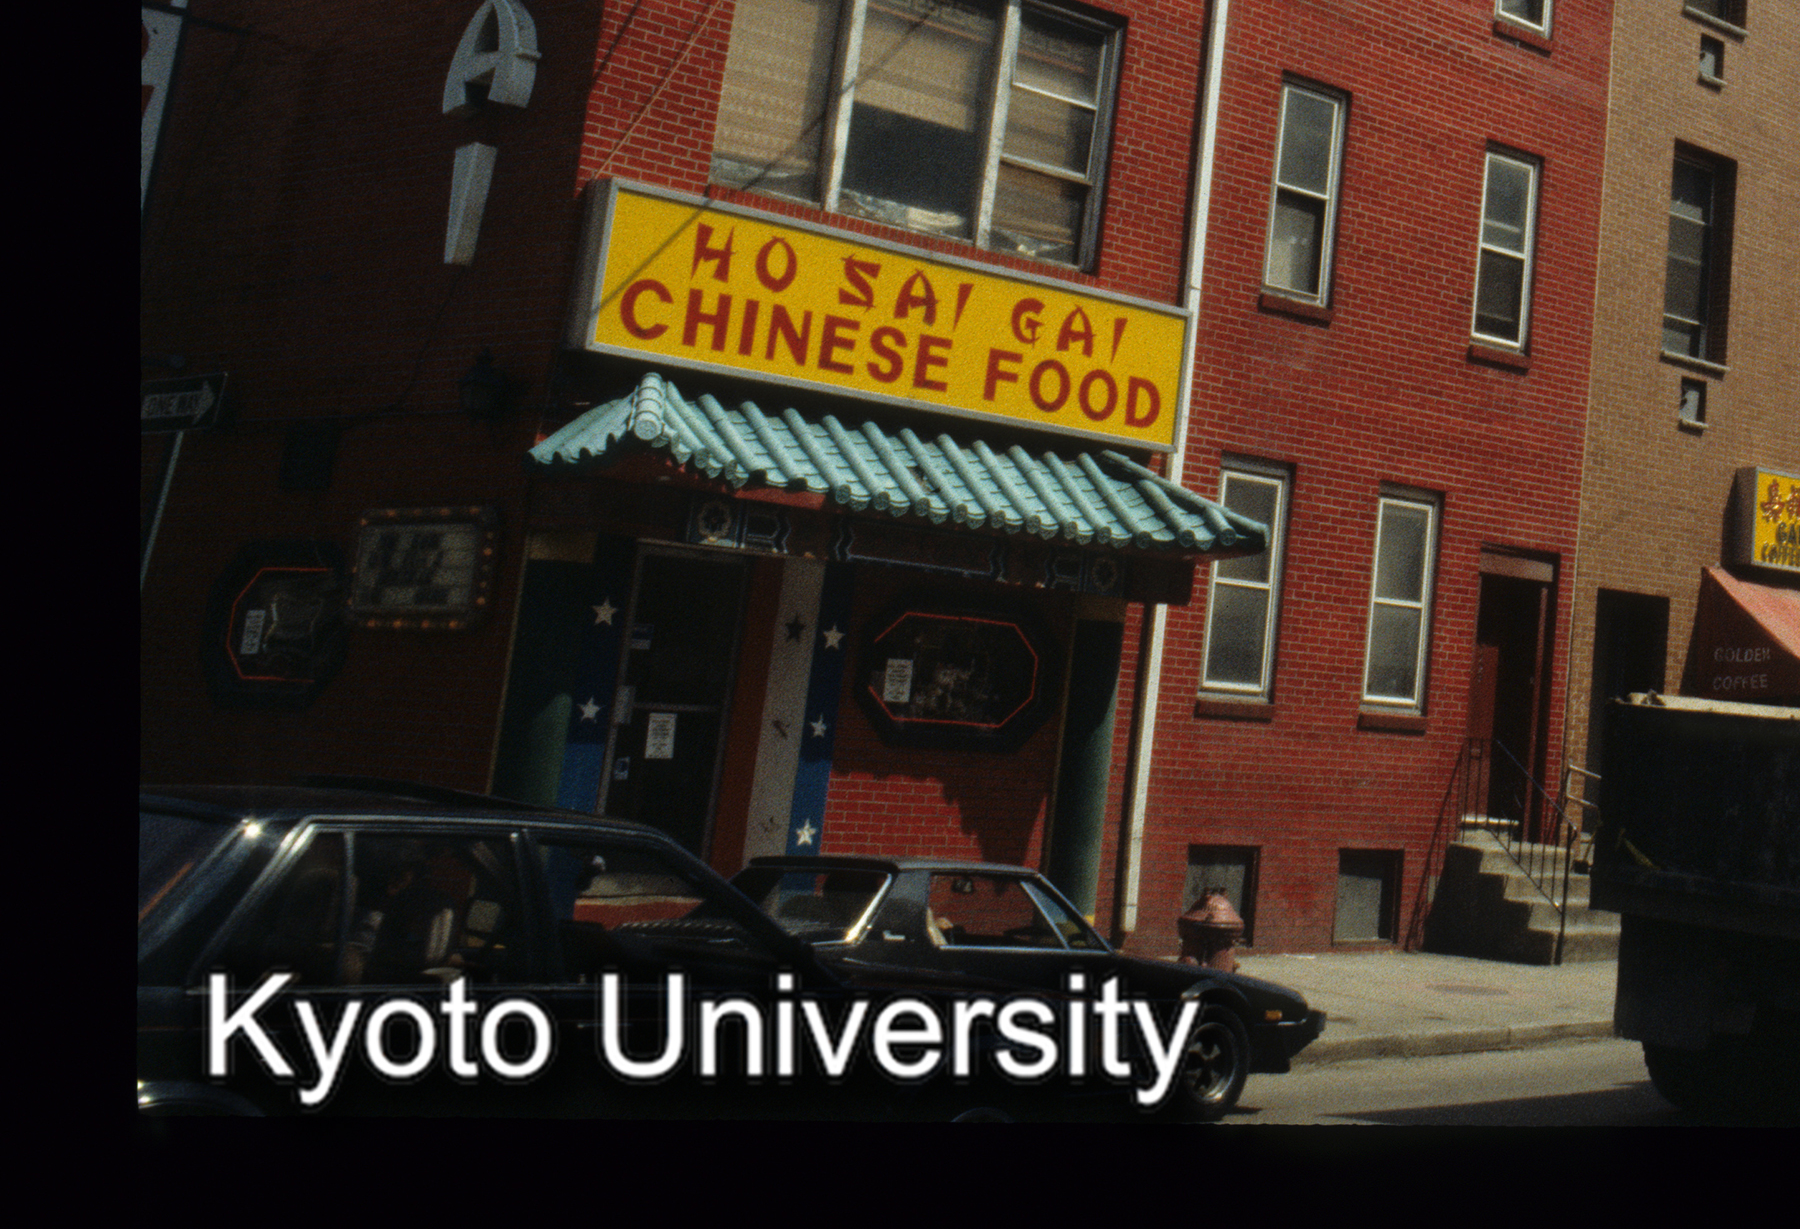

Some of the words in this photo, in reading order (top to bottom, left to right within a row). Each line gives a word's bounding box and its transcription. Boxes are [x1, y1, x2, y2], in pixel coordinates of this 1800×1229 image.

[691, 222, 798, 293] HO
[620, 279, 954, 392] CHINESE
[983, 348, 1160, 429] FOOD
[1714, 647, 1771, 662] GOLDEN
[1713, 674, 1768, 690] COFFEE
